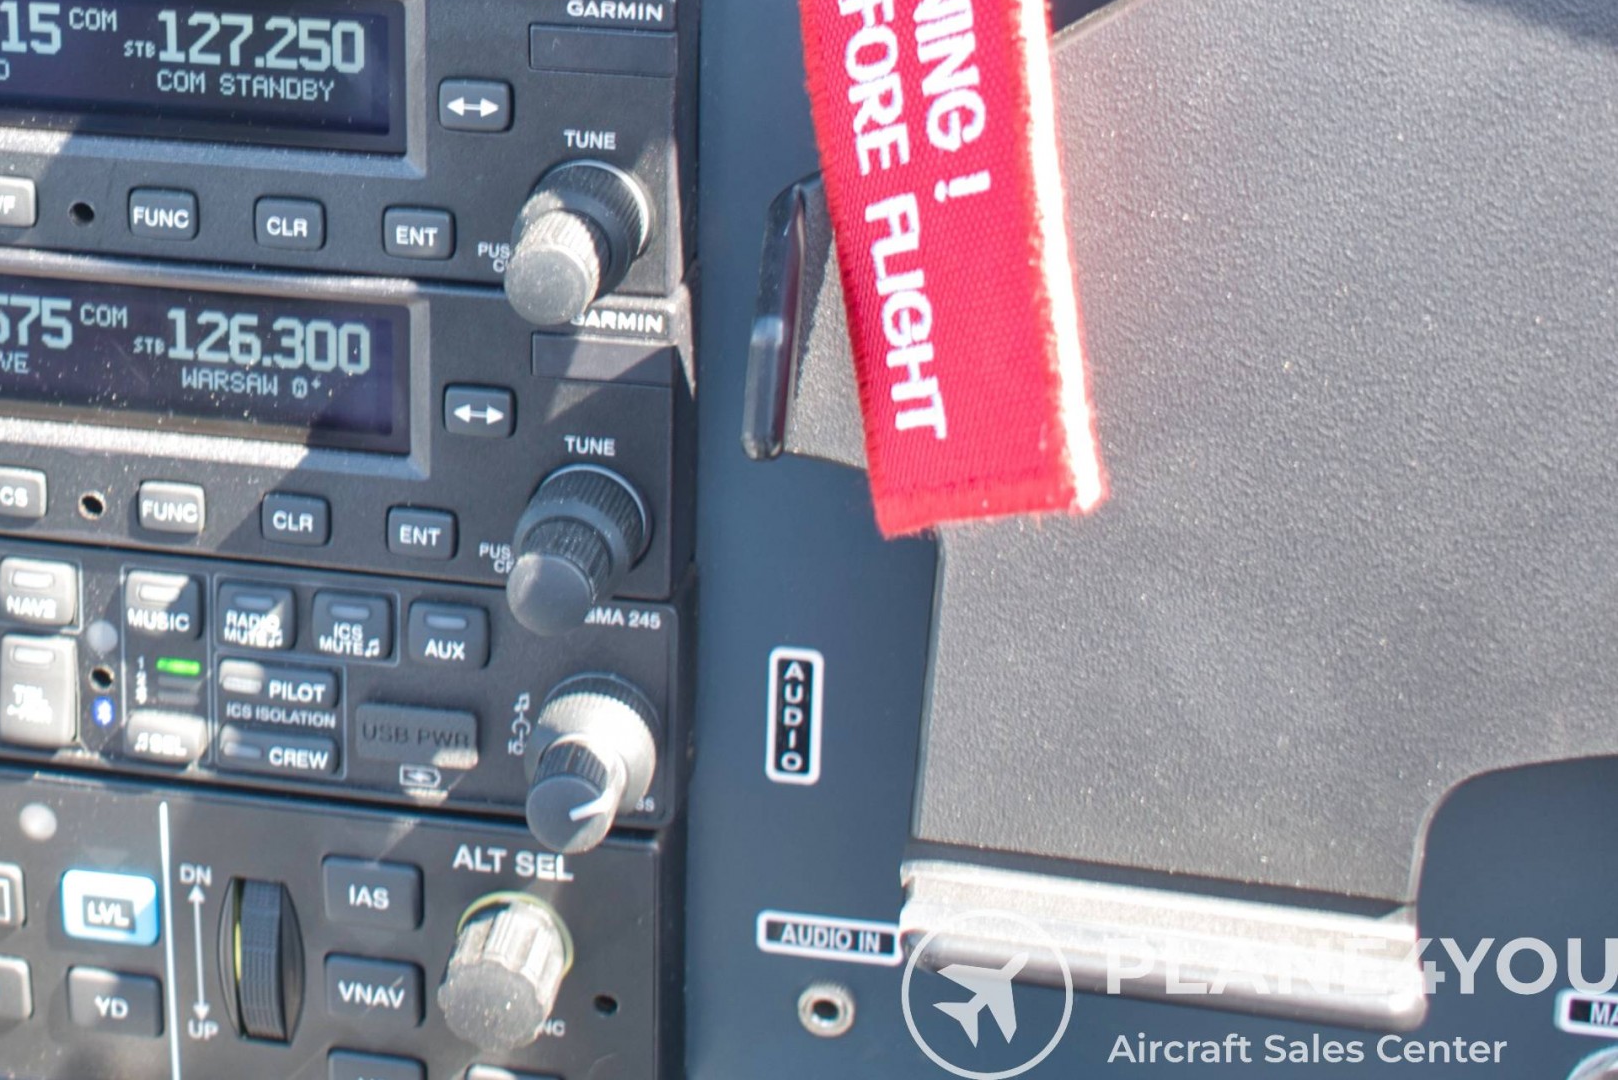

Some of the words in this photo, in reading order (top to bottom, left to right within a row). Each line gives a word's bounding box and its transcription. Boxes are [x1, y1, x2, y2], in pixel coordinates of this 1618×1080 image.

[69, 8, 118, 32] COM
[567, 0, 663, 21] GARMIN
[124, 40, 156, 59] STB
[159, 10, 366, 74] 127.250
[157, 69, 206, 94] COM
[220, 75, 335, 102] STANDBY
[563, 129, 616, 150] TUNE
[133, 205, 189, 229] FUNC
[266, 216, 307, 239] CLR
[396, 227, 437, 247] ENT
[81, 304, 128, 330] COM
[865, 192, 947, 440] FLIGHT
[133, 337, 164, 354] STB
[168, 308, 370, 374] 126.300
[182, 370, 278, 395] WARSAW
[564, 435, 615, 456] TUNE
[141, 500, 198, 521] FUNC
[273, 512, 312, 532] CLR
[400, 526, 441, 546] ENT
[128, 608, 189, 631] MUSIC
[425, 640, 465, 660] AUX
[269, 680, 325, 702] PILOT
[227, 702, 252, 718] ICS
[256, 704, 335, 728] ISOLATION
[782, 660, 806, 772] AUDIO
[269, 747, 328, 769] CREW
[180, 864, 211, 886] DN
[453, 845, 505, 873] ALT
[516, 851, 573, 882] SEL
[349, 886, 389, 909] IAS
[88, 902, 129, 926] LVL
[782, 925, 852, 951] AUDIO
[859, 929, 880, 953] IN
[339, 981, 404, 1009] VNAV
[95, 996, 128, 1018] YD
[188, 1020, 217, 1040] UP
